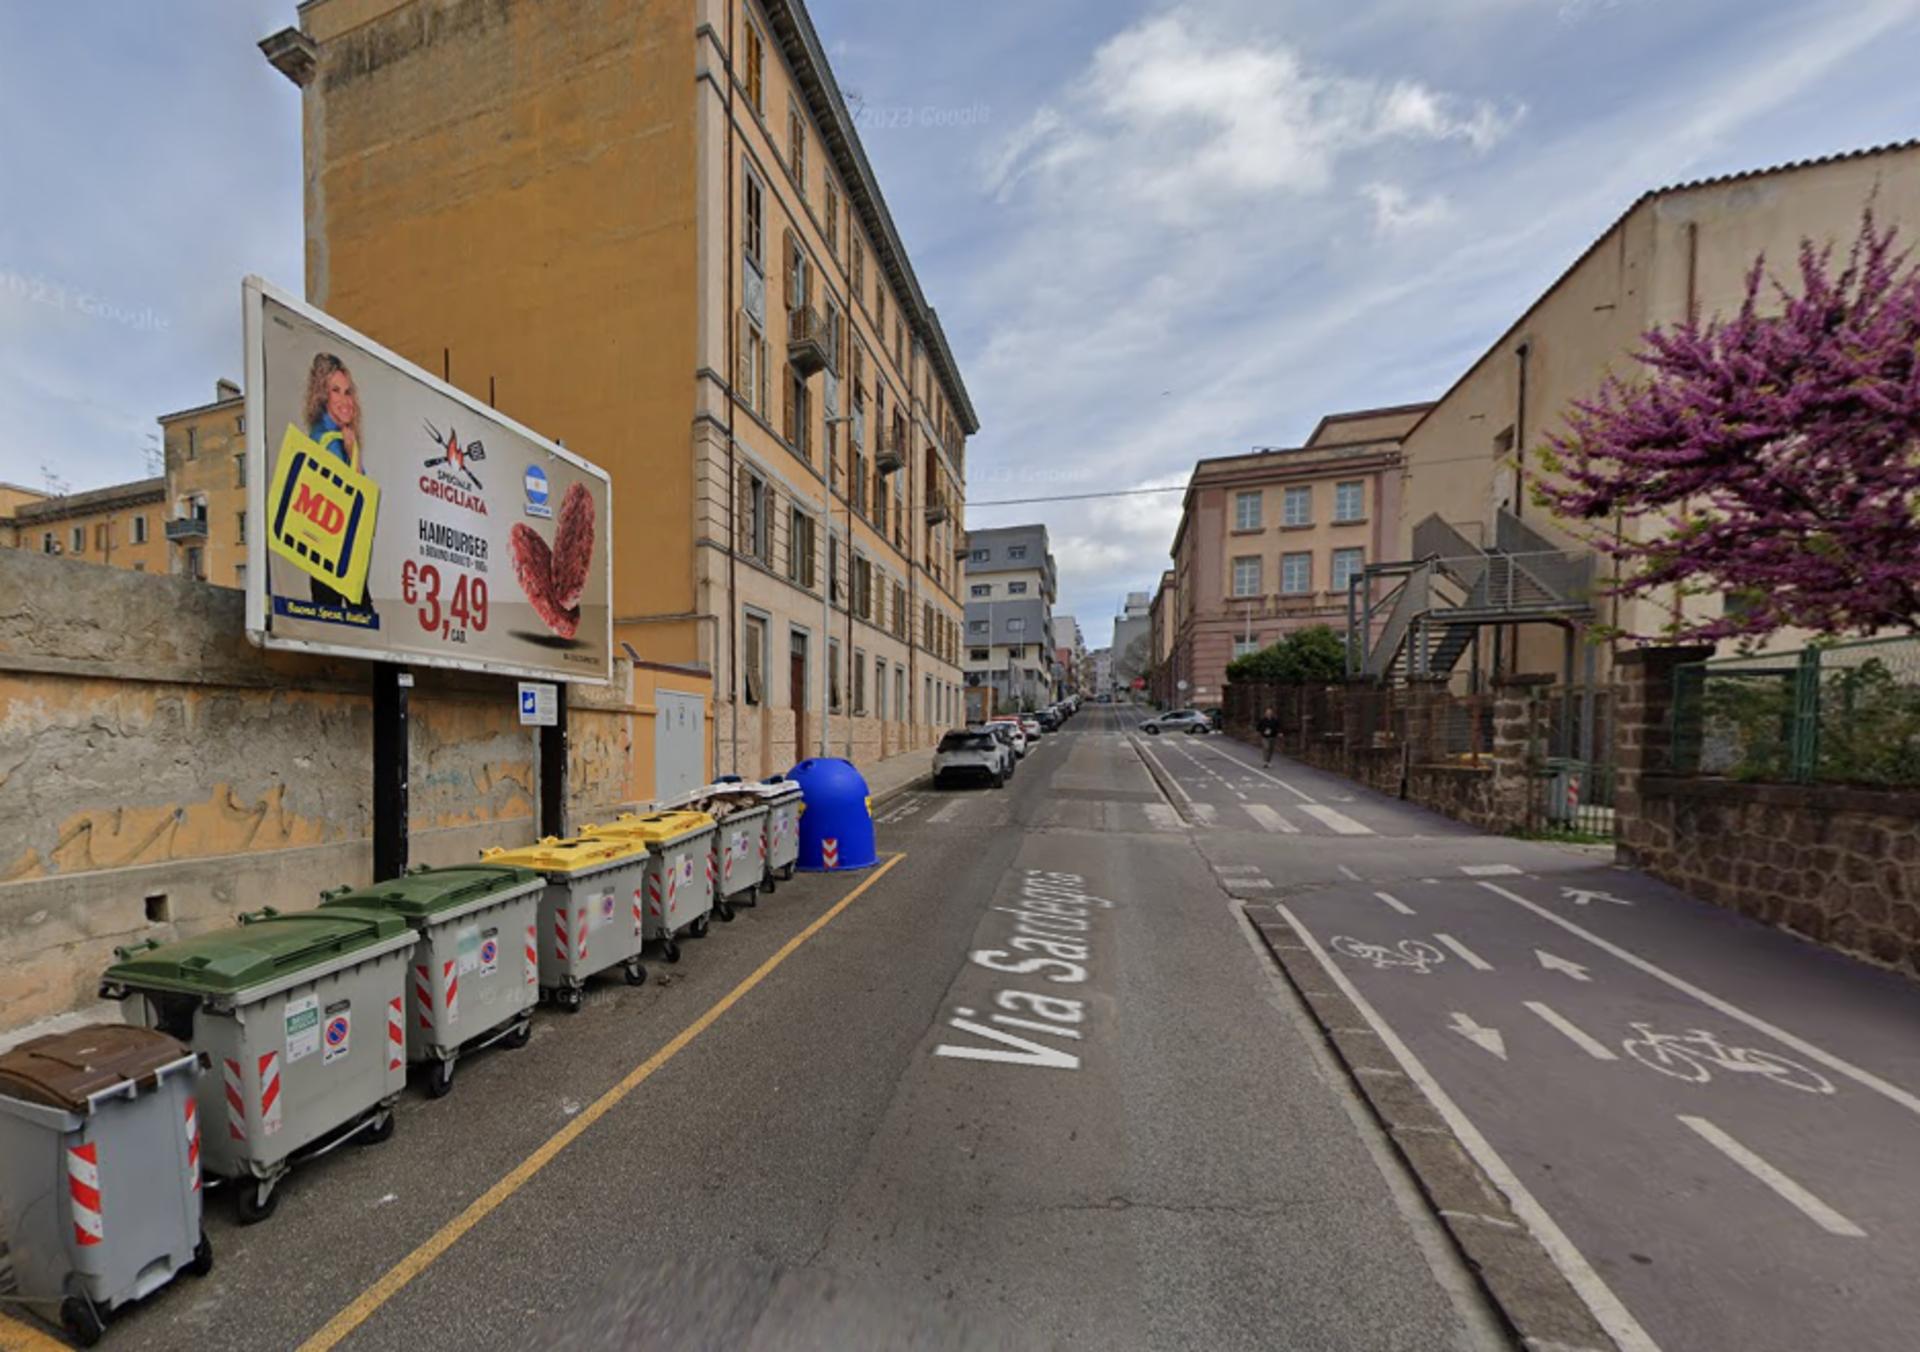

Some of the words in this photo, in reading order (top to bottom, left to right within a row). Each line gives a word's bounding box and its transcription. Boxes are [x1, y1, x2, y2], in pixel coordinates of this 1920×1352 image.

[292, 482, 345, 535] MD
[419, 475, 488, 516] GRIGLIATA
[419, 517, 489, 560] HAMBURGER
[970, 869, 1113, 982] Sardegna
[936, 990, 1080, 1068] Via
